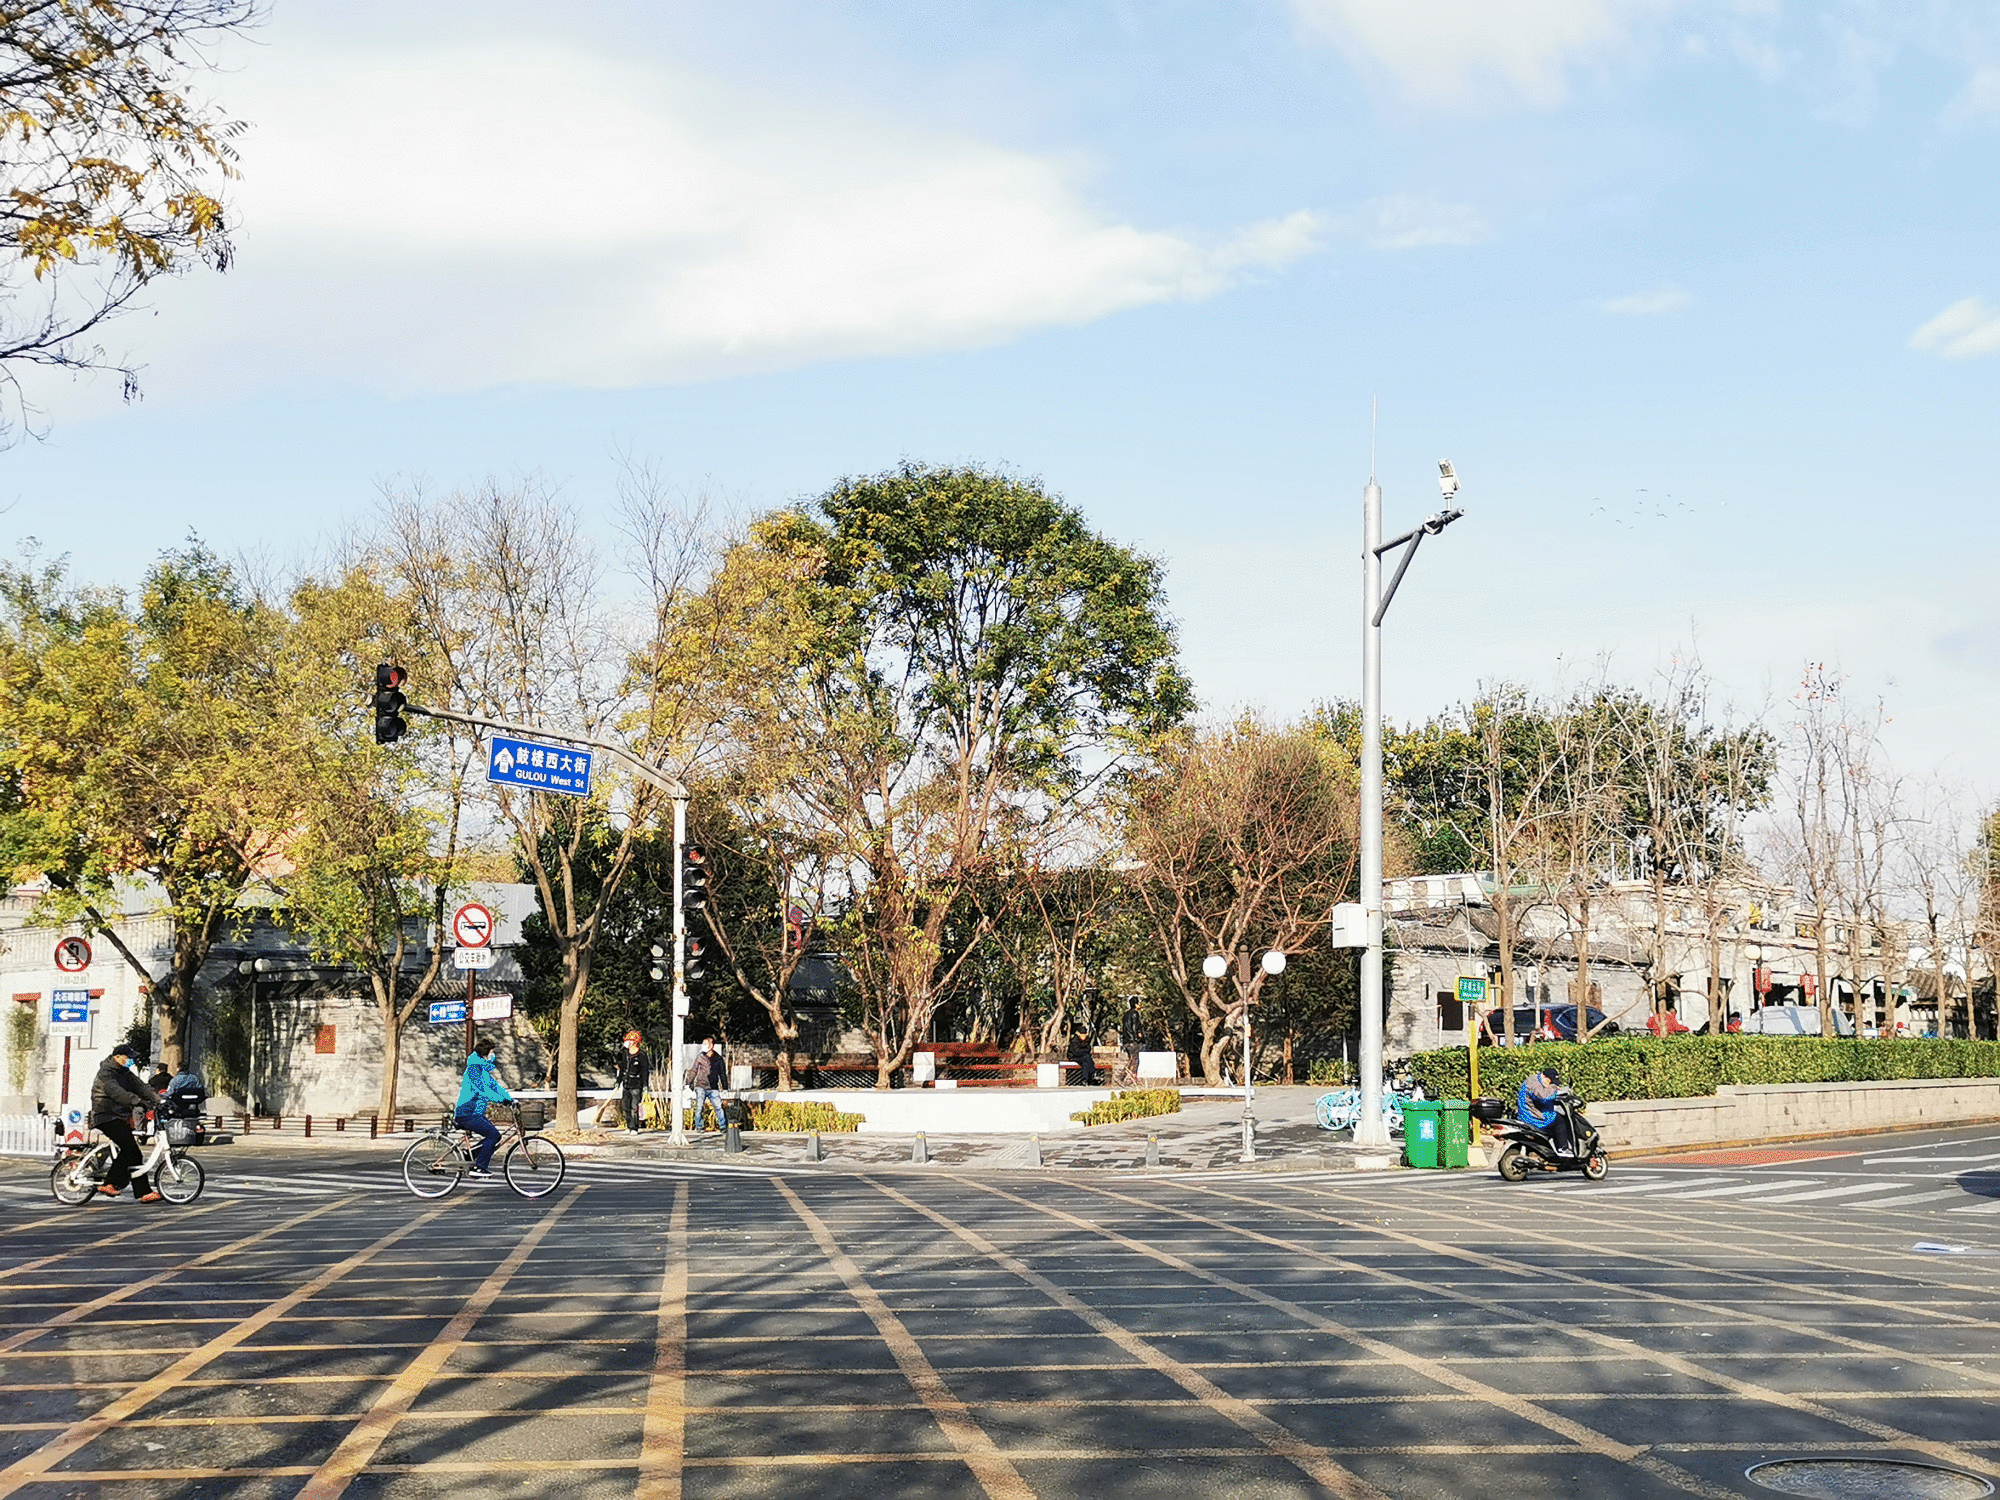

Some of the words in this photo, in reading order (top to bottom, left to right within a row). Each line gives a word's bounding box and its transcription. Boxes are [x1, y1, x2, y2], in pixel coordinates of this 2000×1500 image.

[516, 746, 588, 775] 鼓楼西大街
[515, 769, 547, 783] GULOU
[551, 774, 572, 787] West
[575, 778, 585, 789] St
